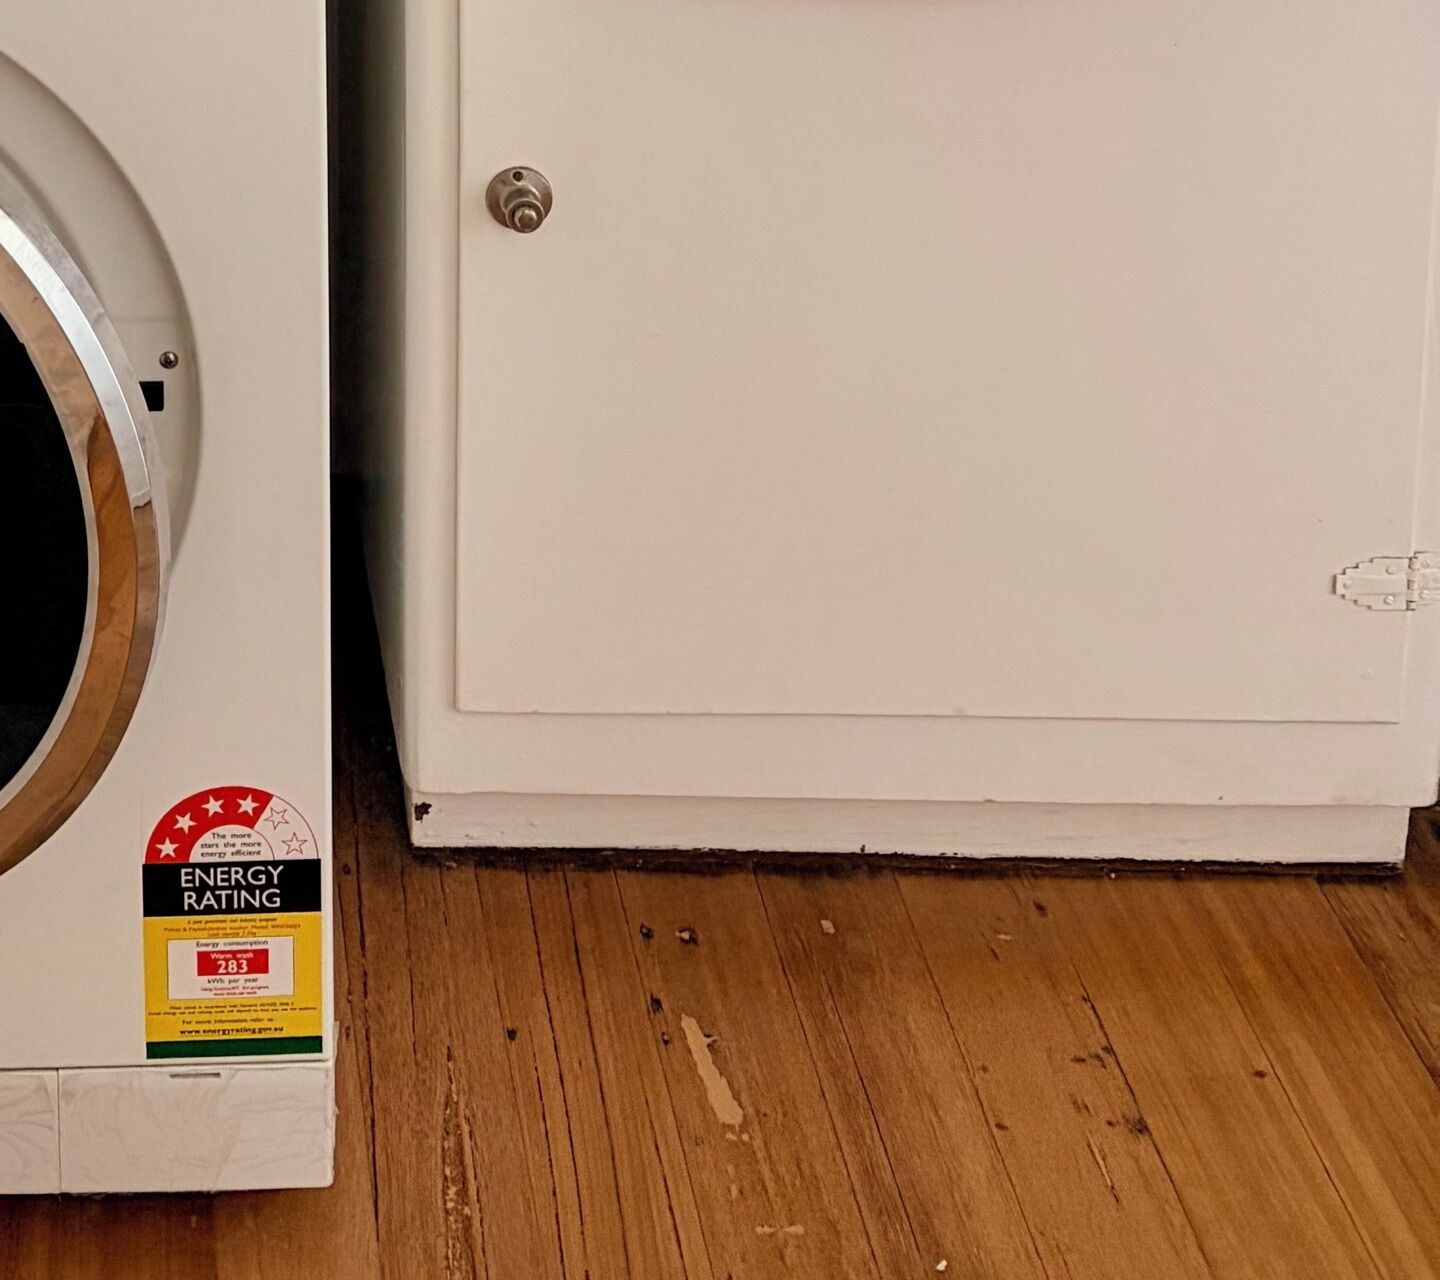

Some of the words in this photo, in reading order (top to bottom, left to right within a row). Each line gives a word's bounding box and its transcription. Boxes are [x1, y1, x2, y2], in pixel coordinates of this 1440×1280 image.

[211, 832, 227, 840] The
[231, 849, 262, 857] efficient
[180, 865, 284, 888] ENERGY
[183, 889, 281, 912] RATING
[217, 960, 248, 974] 283
